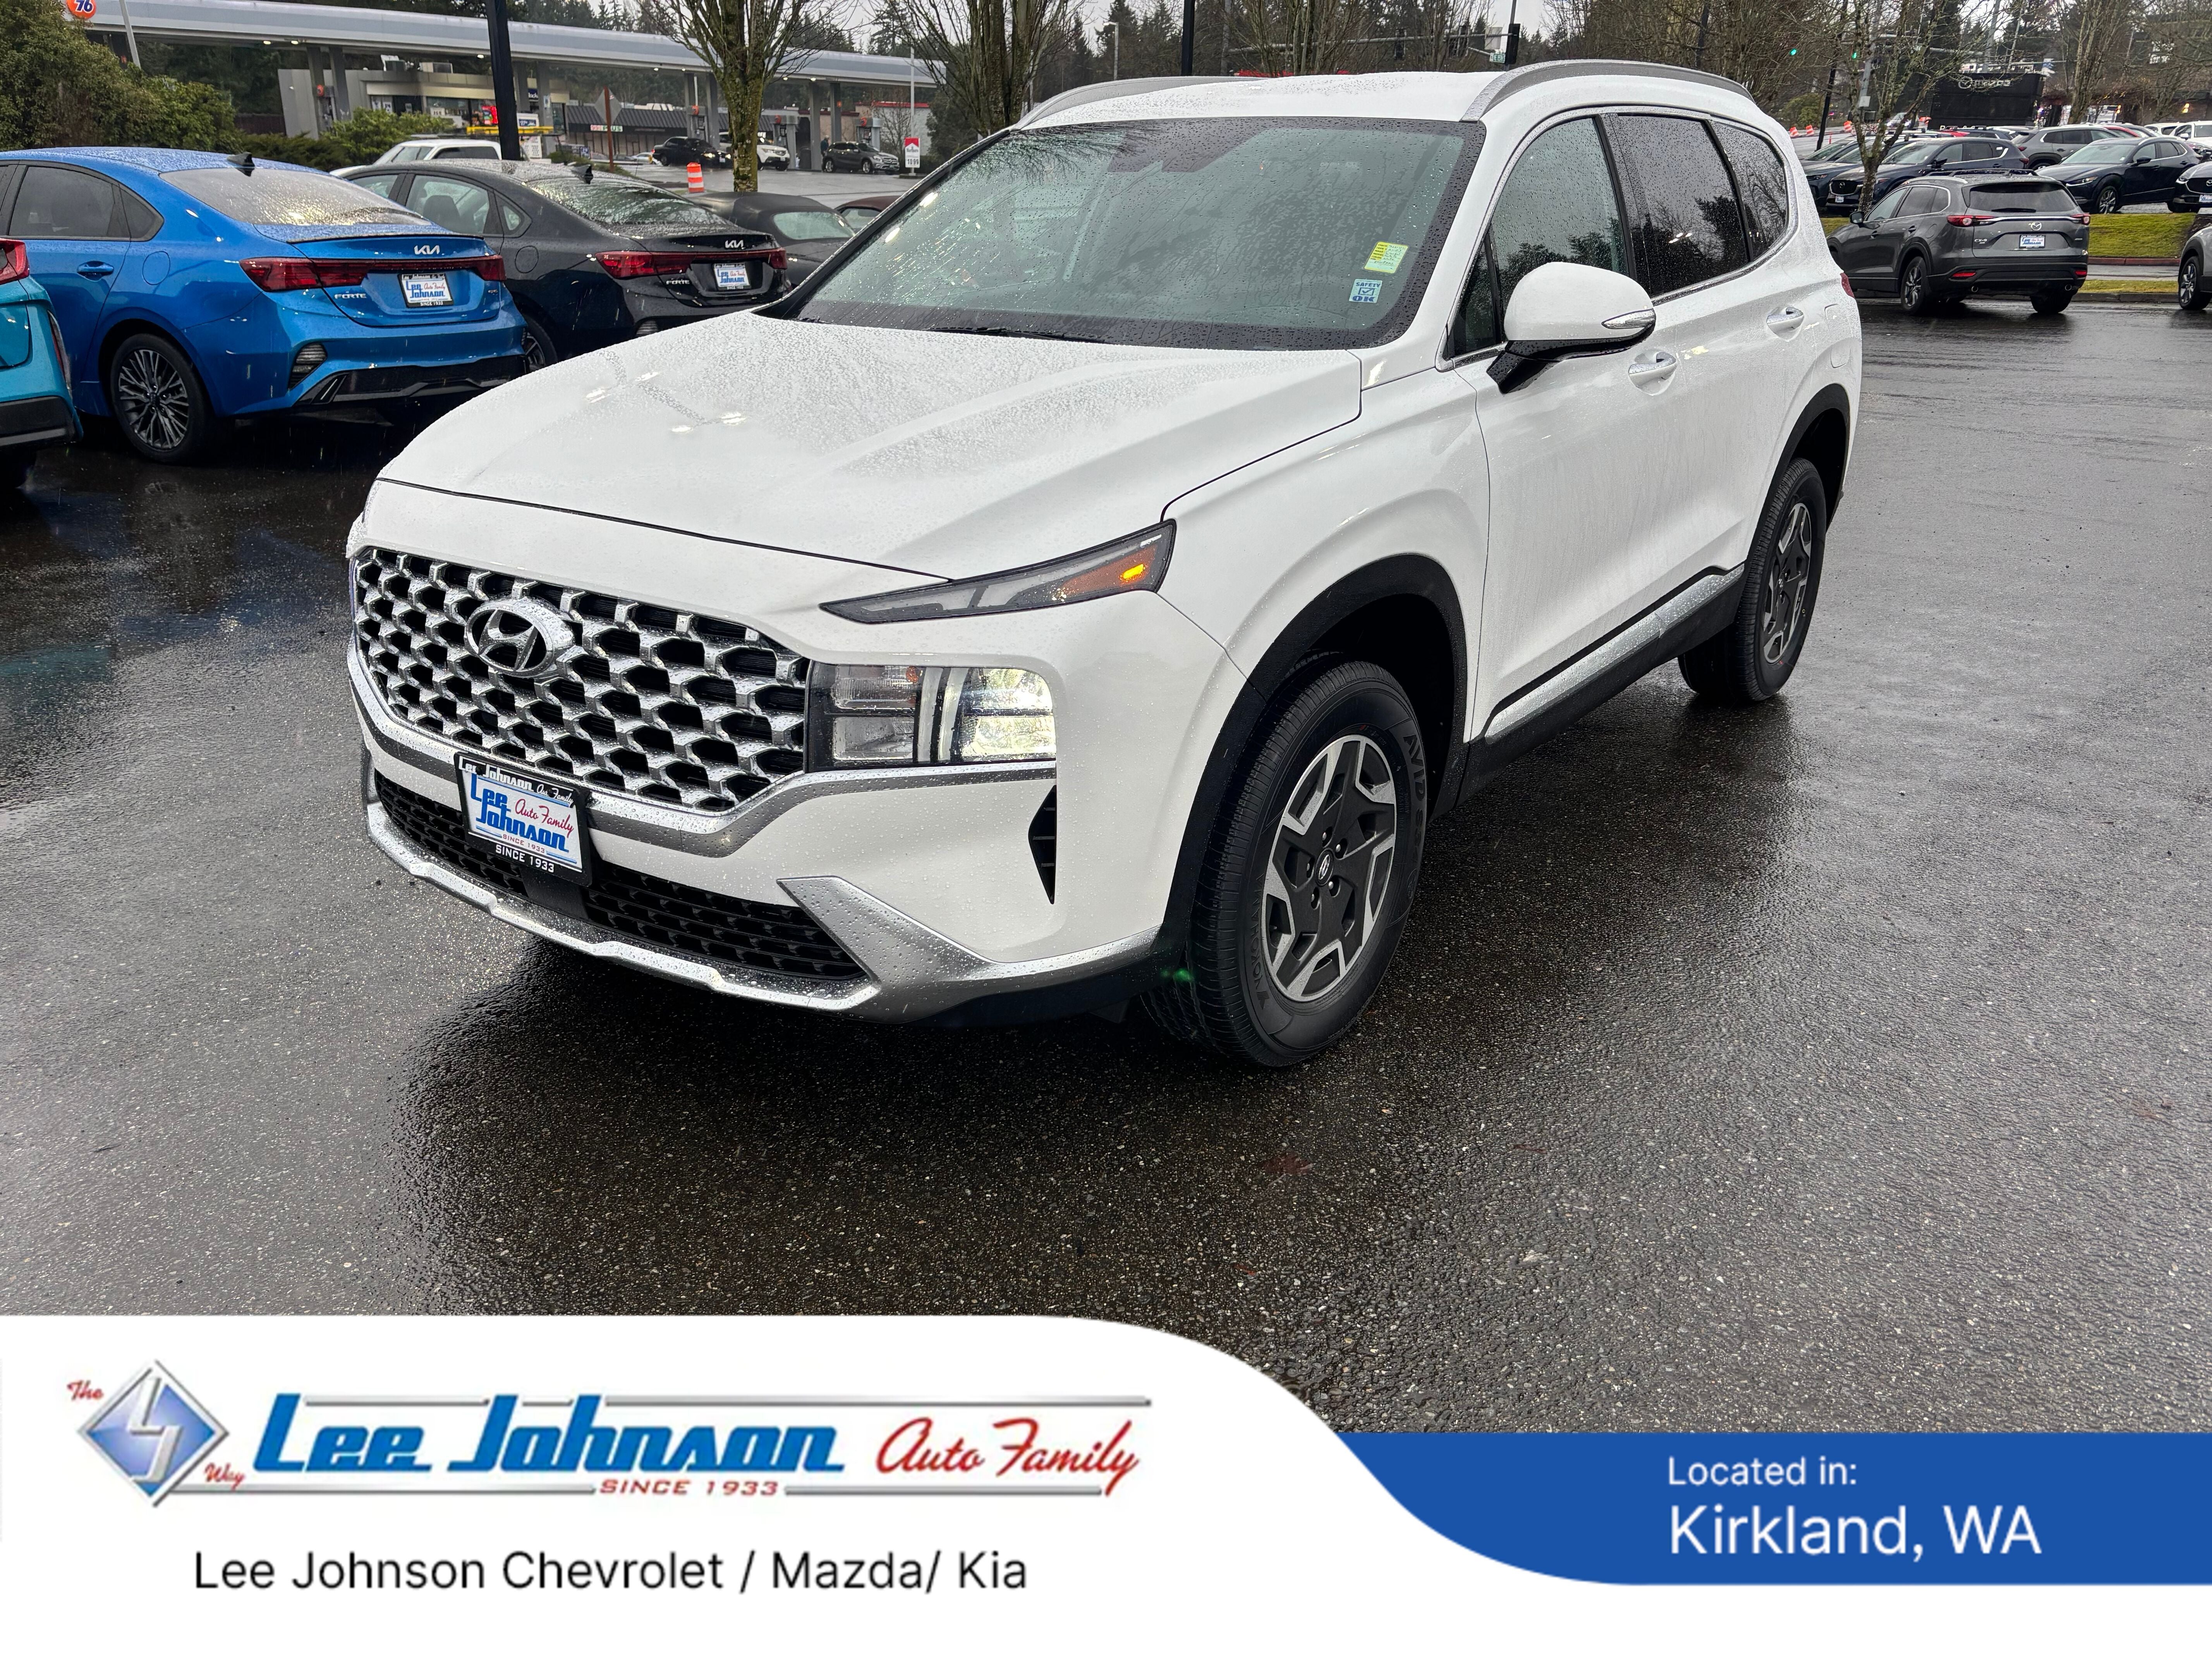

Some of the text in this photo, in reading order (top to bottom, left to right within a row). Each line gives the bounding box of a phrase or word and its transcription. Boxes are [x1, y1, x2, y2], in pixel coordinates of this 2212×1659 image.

[75, 0, 94, 13] 76
[414, 245, 440, 255] KIA
[725, 240, 744, 248] KIA
[406, 280, 423, 290] Lee
[410, 289, 445, 298] Johnson
[1403, 735, 1426, 801] AVID
[483, 764, 534, 792] Johnson
[551, 788, 574, 808] Family
[471, 774, 574, 838] Lee Auto Family
[476, 802, 569, 853] Johnson
[502, 834, 545, 854] SINCE 1933
[495, 844, 555, 873] SINCE 1933
[1250, 873, 1264, 989] YOKOHAMA
